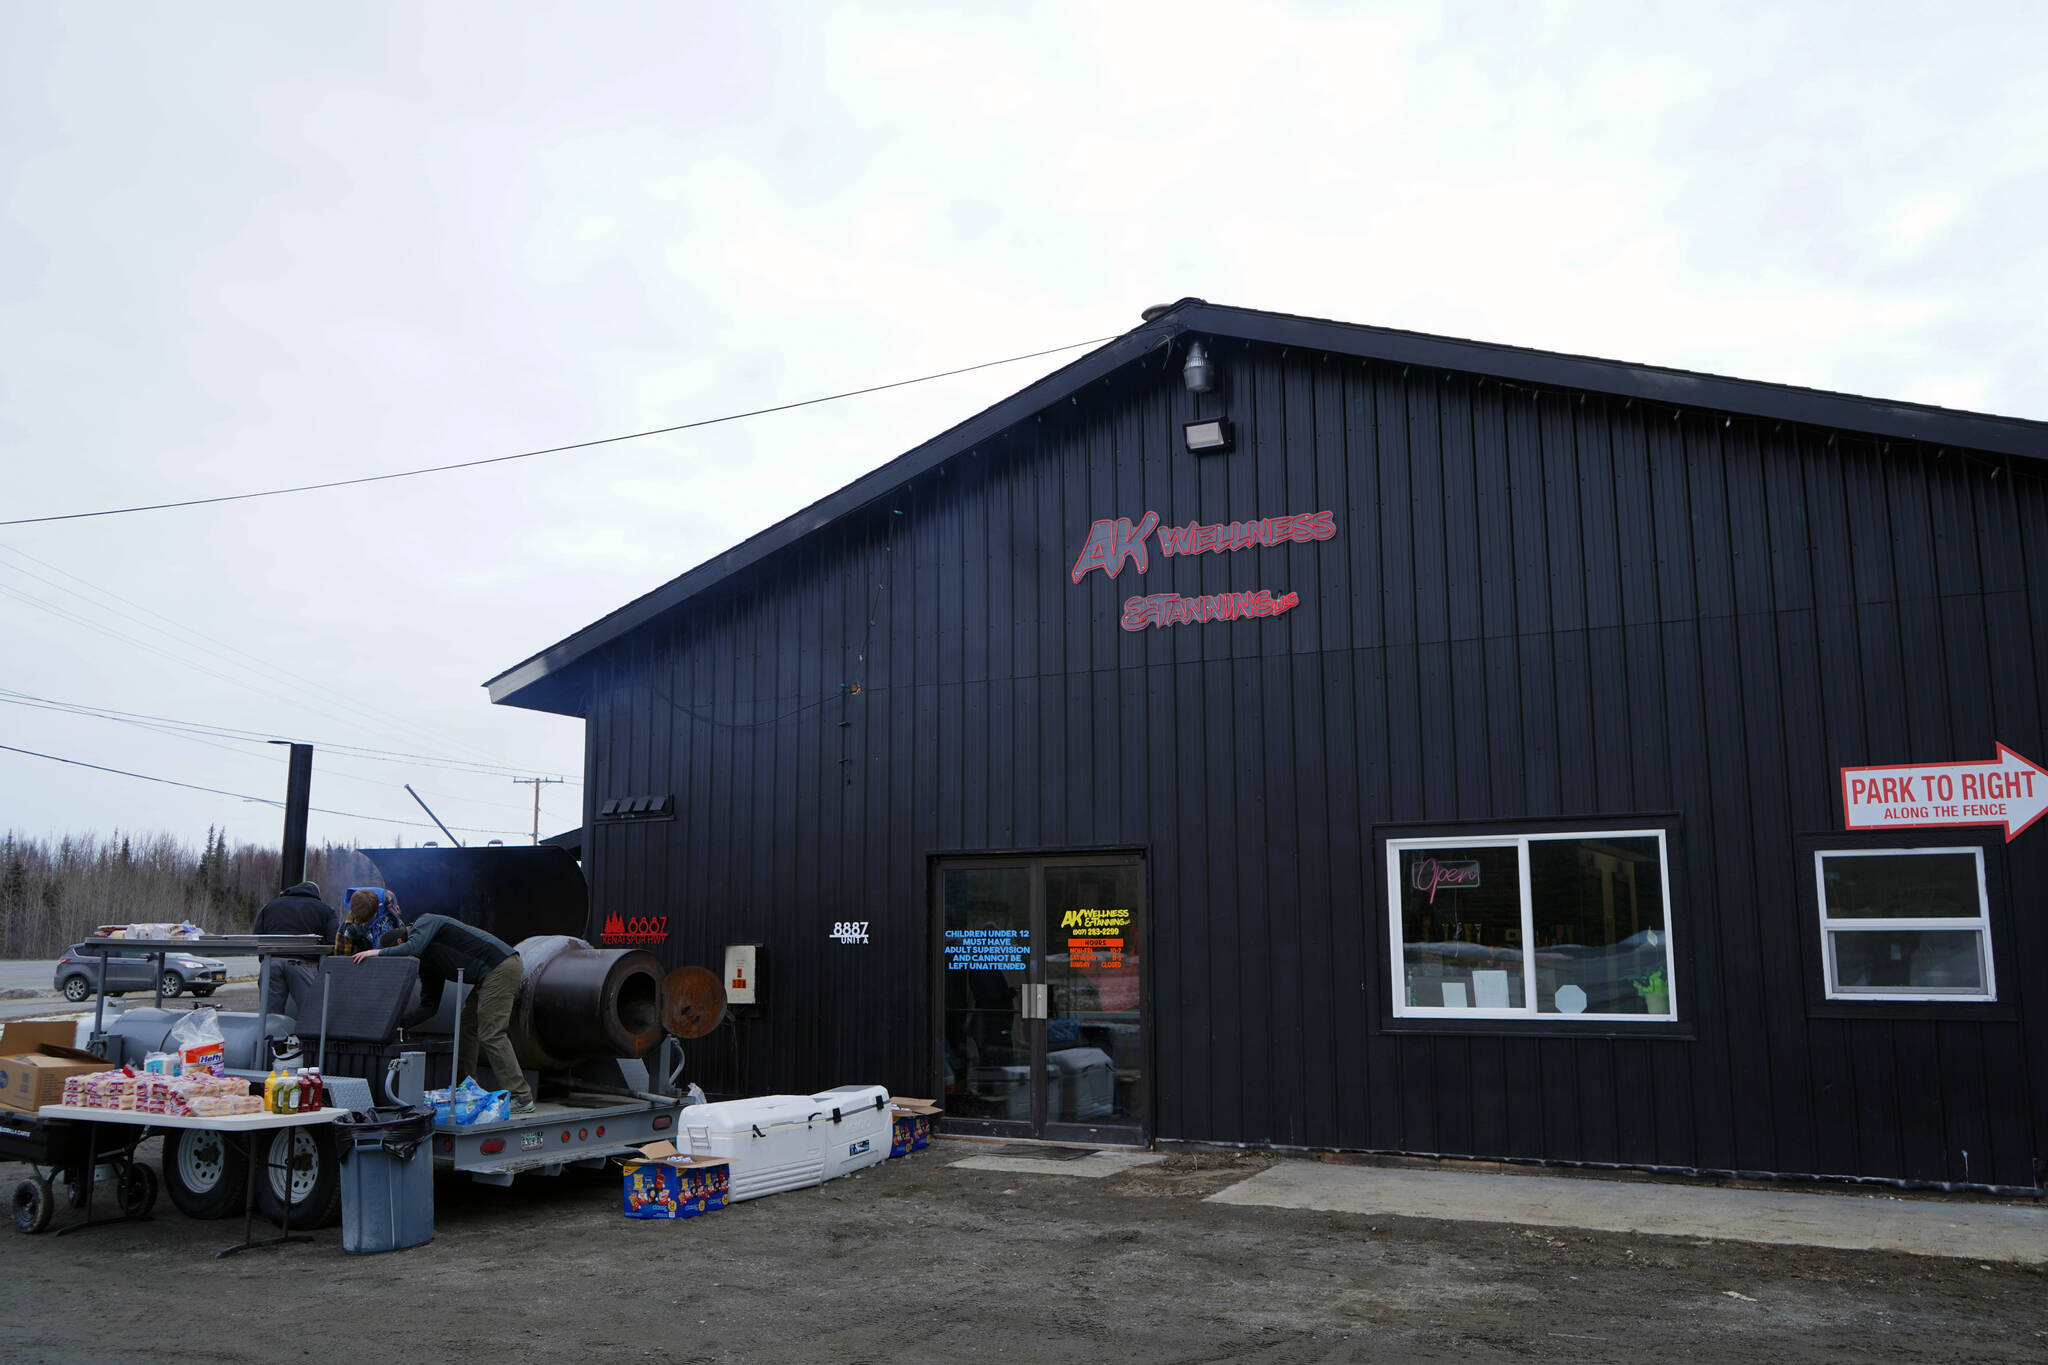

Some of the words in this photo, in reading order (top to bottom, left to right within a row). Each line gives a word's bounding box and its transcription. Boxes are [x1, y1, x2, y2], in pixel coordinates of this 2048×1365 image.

[1072, 510, 1159, 584] AK
[1157, 511, 1337, 557] WELLNESS
[1851, 775, 1916, 805] PARK
[1921, 774, 1954, 802] TO
[1961, 771, 2036, 800] RIGHT
[1884, 806, 1929, 819] ALONG
[1933, 805, 1959, 817] THE
[1963, 803, 2007, 816] FENCE
[1417, 858, 1477, 904] Open
[1061, 909, 1086, 928] AK
[1085, 908, 1129, 918] WELLNESS
[833, 921, 869, 936] 8887
[945, 930, 987, 938] CHILDREN
[988, 930, 1017, 938] UNDER
[1019, 930, 1030, 938] 12
[840, 936, 861, 944] UNIT
[962, 938, 987, 946] MUST
[988, 938, 1011, 946] HAVE
[944, 946, 971, 954] ADULT
[972, 946, 1031, 954] SUPERVISION
[952, 954, 971, 962] AND
[971, 954, 1009, 962] CANNOT
[1010, 954, 1022, 962] BE
[948, 962, 969, 970] LEFT
[969, 962, 1026, 970] UNATTENDED
[200, 1054, 222, 1063] Hefty
